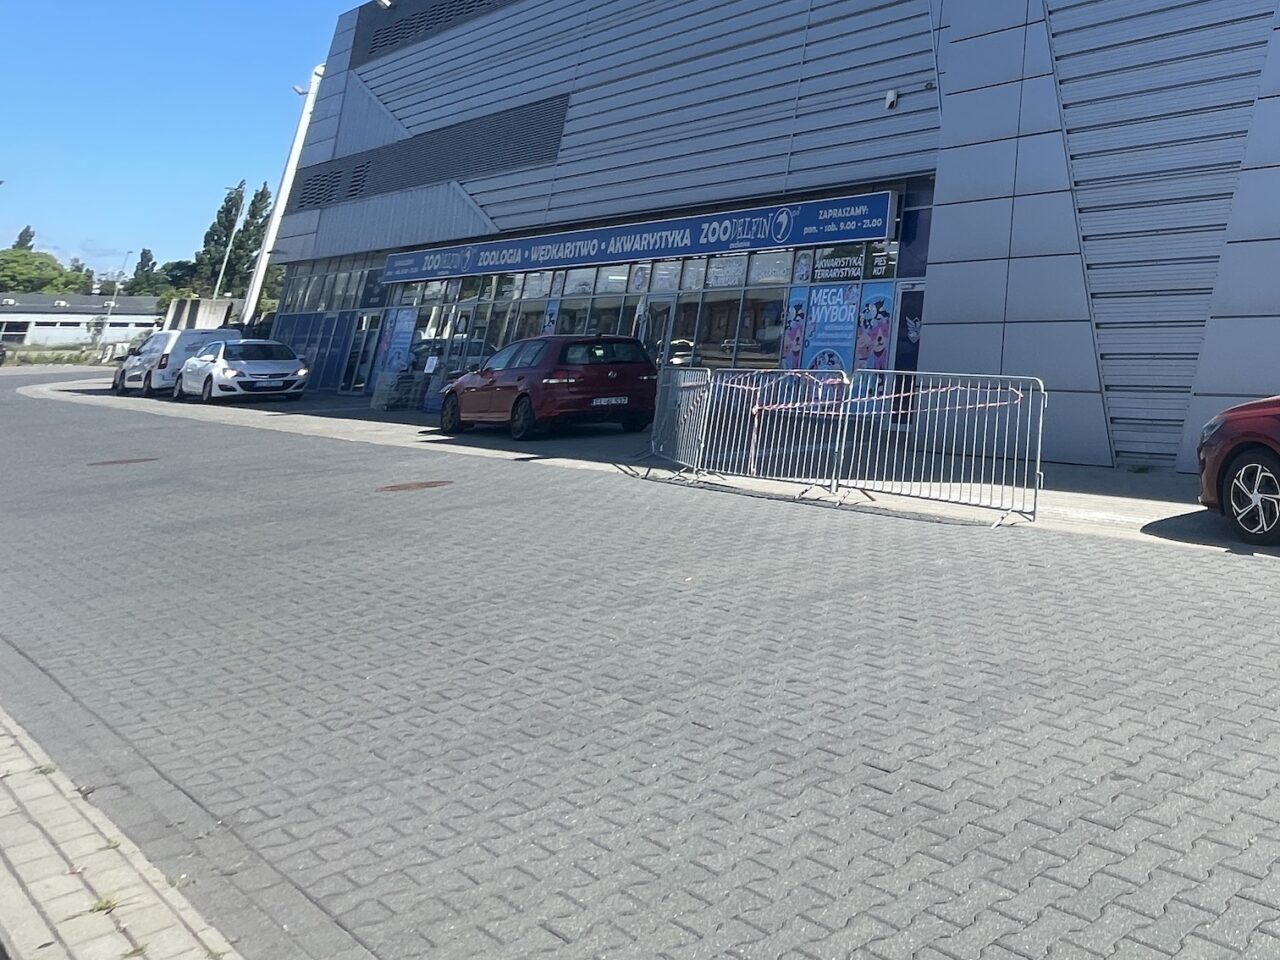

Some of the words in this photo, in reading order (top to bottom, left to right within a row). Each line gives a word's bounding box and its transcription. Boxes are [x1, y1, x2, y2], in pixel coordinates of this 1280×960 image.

[818, 204, 869, 220] ZAPRASZAMY:
[839, 220, 857, 231] 9.00
[862, 217, 883, 229] 21.00
[477, 248, 521, 267] ZOOLOGIA
[530, 238, 598, 264] WĘDKARSTWO
[606, 228, 691, 255] AKWARYSTYKA
[814, 257, 862, 269] AKWARYSTYKA
[873, 256, 887, 266] PIES
[813, 267, 861, 279] TERRARYSTYKA
[872, 267, 886, 276] KOT
[809, 287, 844, 306] MEGA
